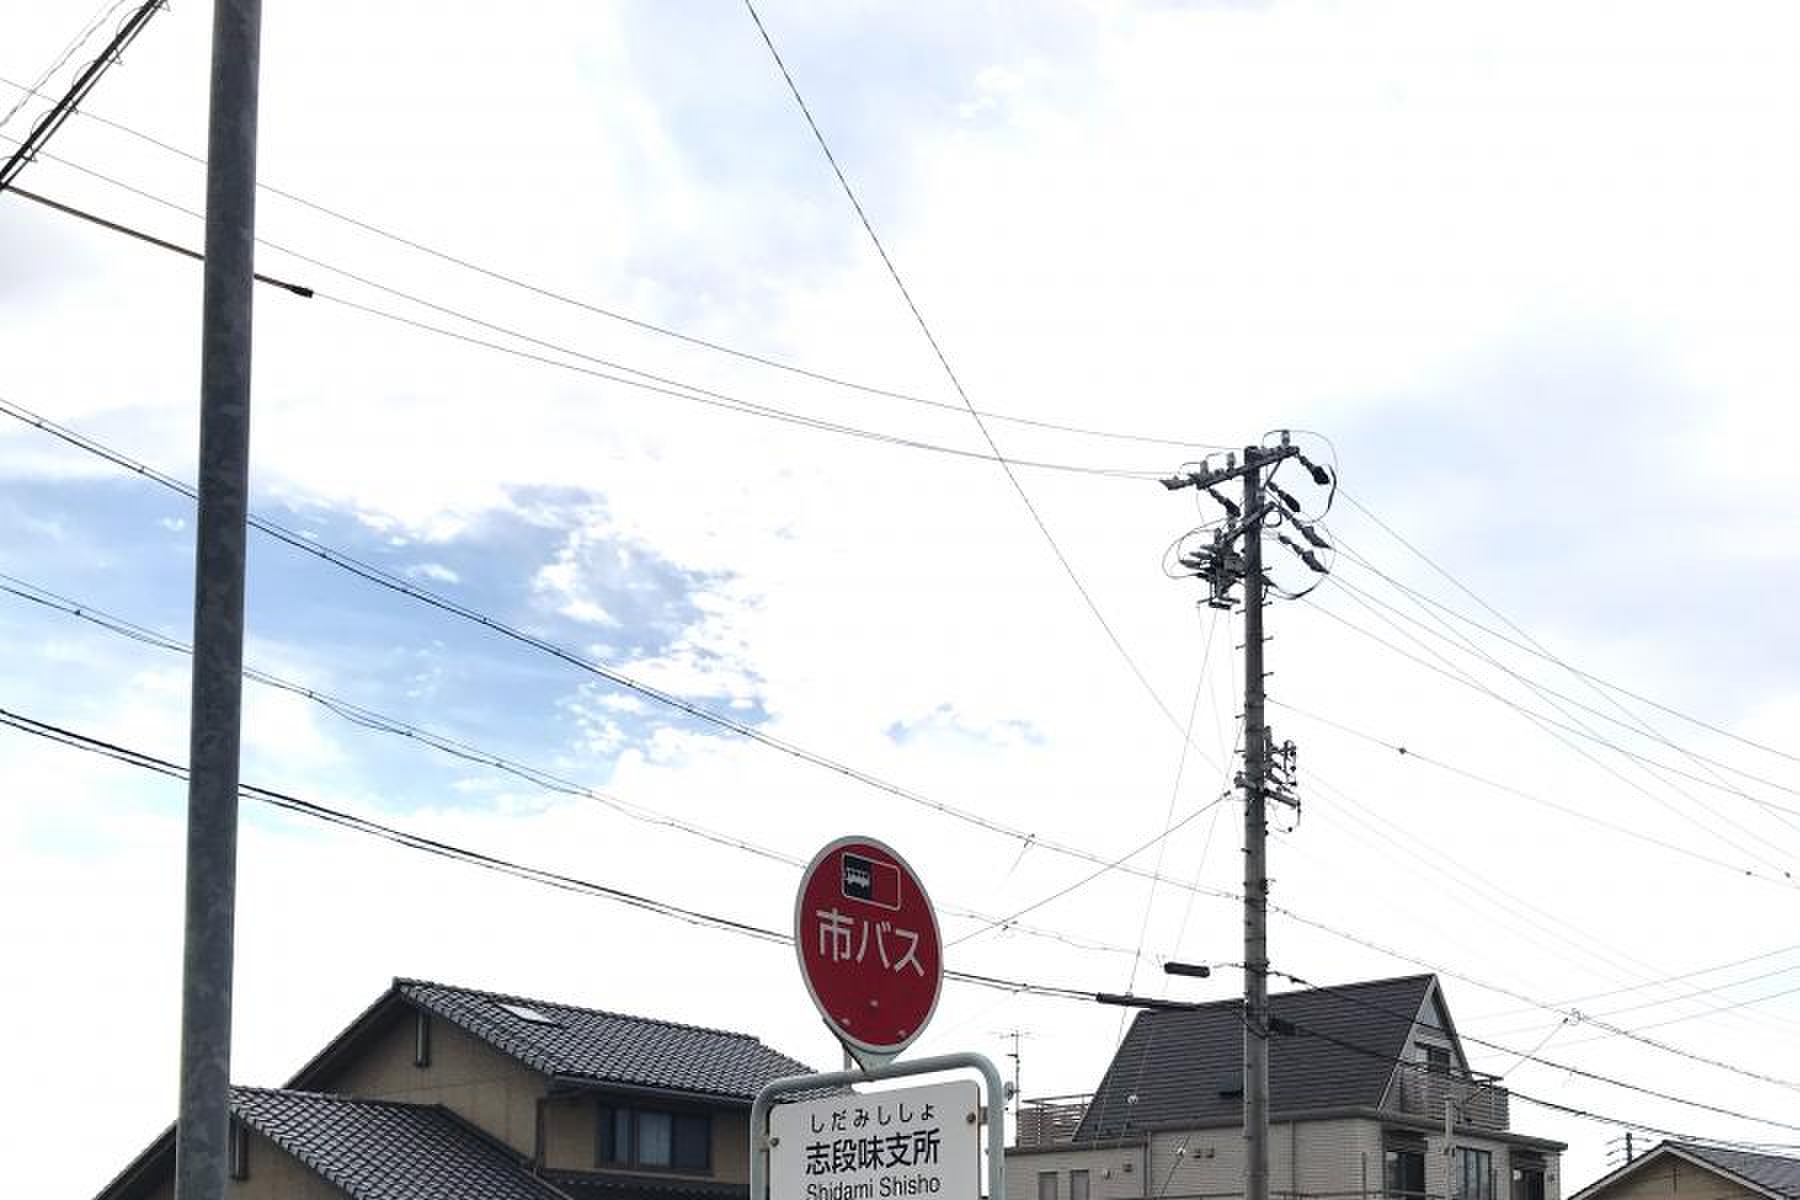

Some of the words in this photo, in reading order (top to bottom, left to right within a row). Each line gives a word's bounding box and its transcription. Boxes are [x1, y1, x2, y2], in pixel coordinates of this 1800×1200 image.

[815, 907, 925, 977] 市バス
[811, 1103, 935, 1133] しだみししょ
[805, 1127, 941, 1175] 志段味支所
[879, 1174, 941, 1198] Shisho
